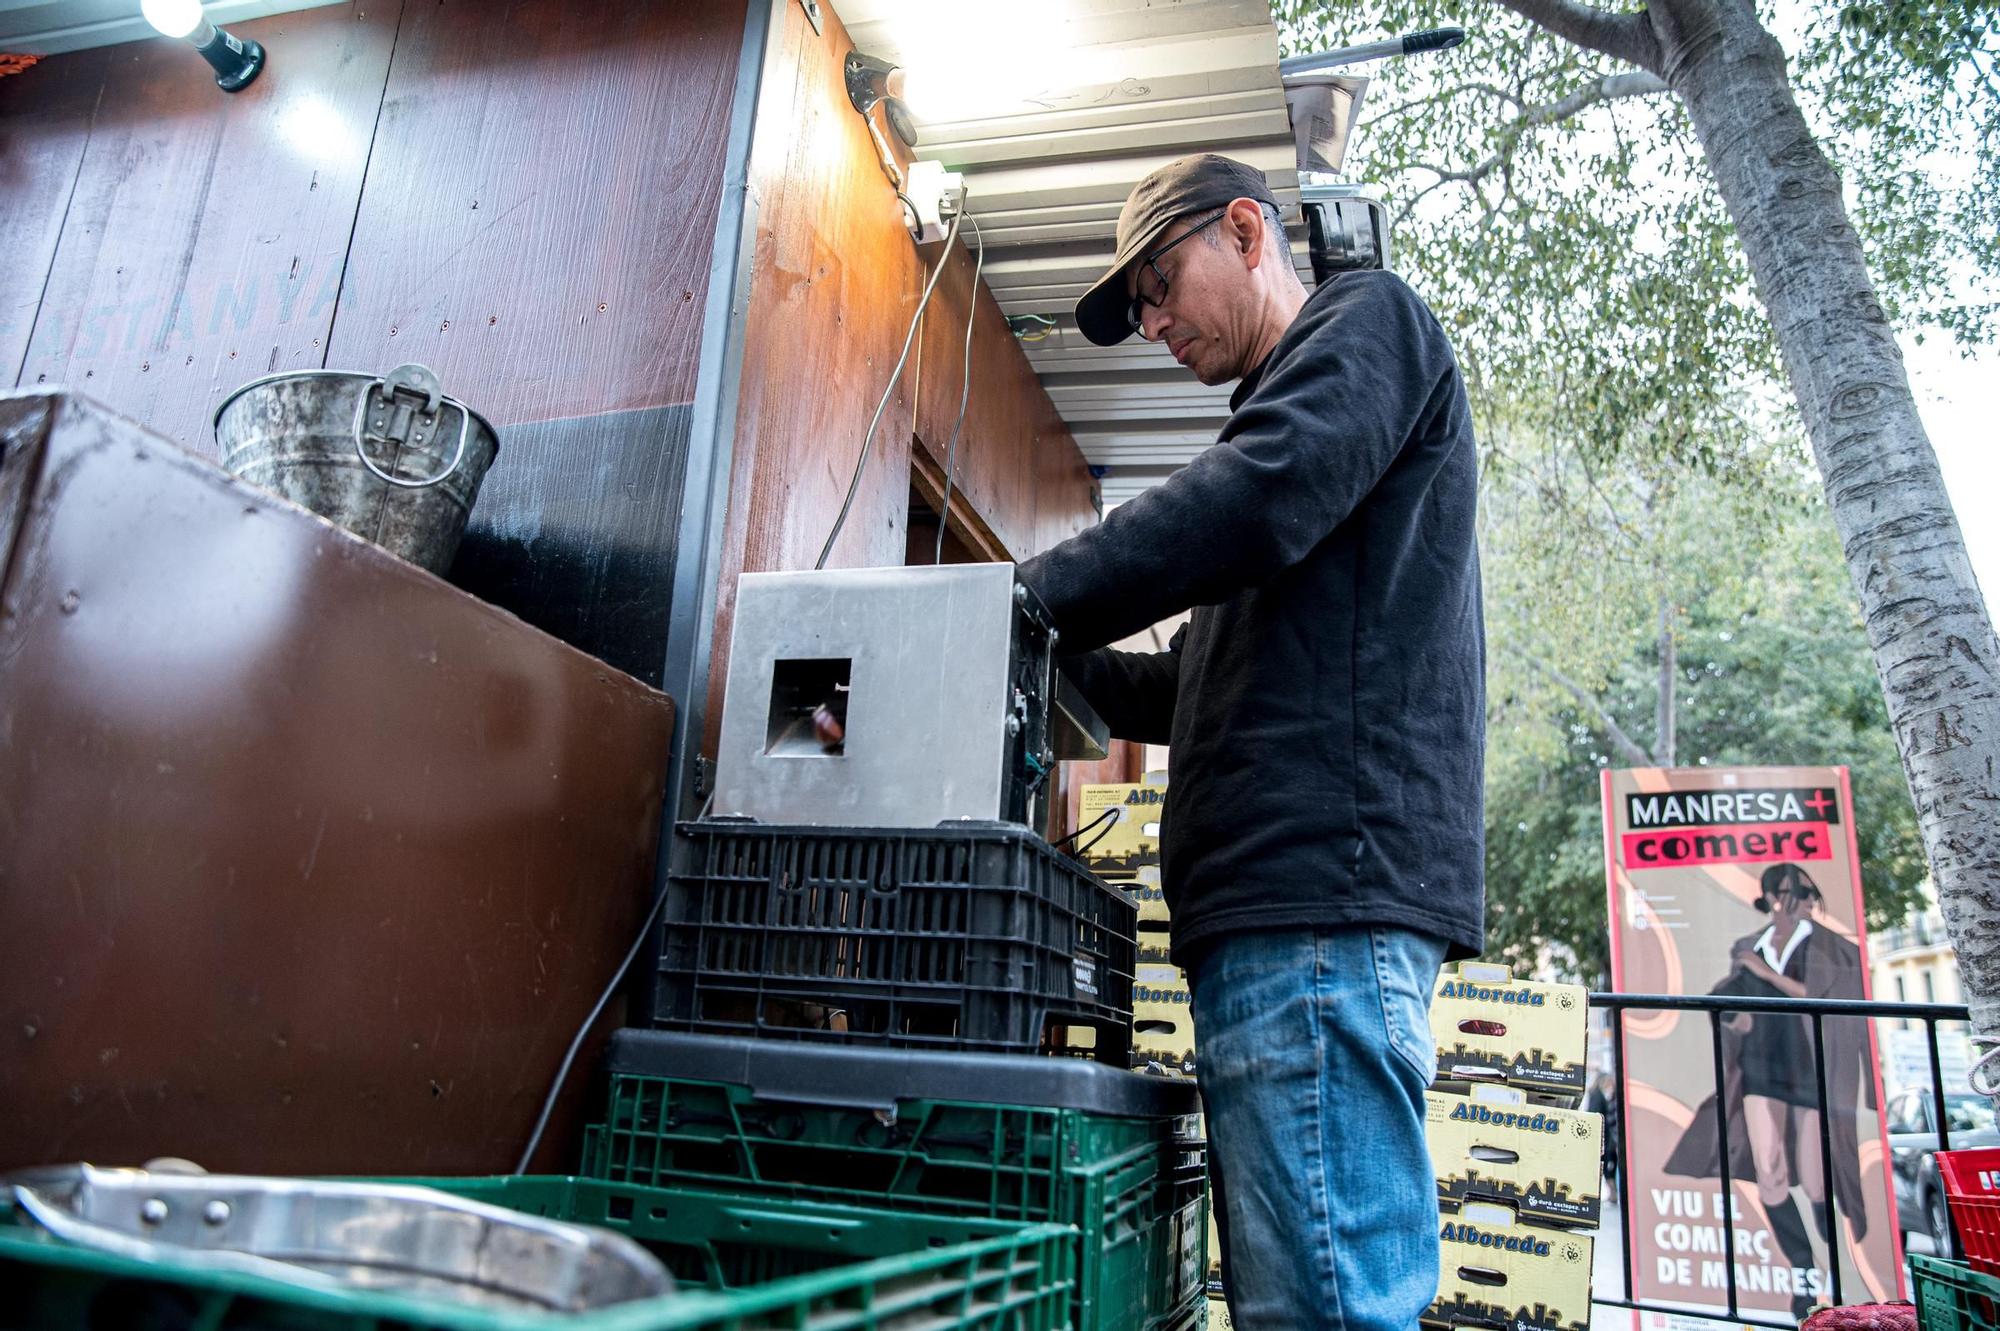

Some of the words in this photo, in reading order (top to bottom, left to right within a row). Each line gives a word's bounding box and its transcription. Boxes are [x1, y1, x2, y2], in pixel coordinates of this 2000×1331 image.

[1636, 830, 1818, 861] comerç
[1438, 981, 1545, 1006] Alborada
[1449, 1102, 1560, 1134] Alborada
[1651, 1188, 1704, 1219] VIU
[1712, 1193, 1743, 1222] EL
[1440, 1221, 1550, 1257] Alborada
[1657, 1256, 1692, 1286] DE
